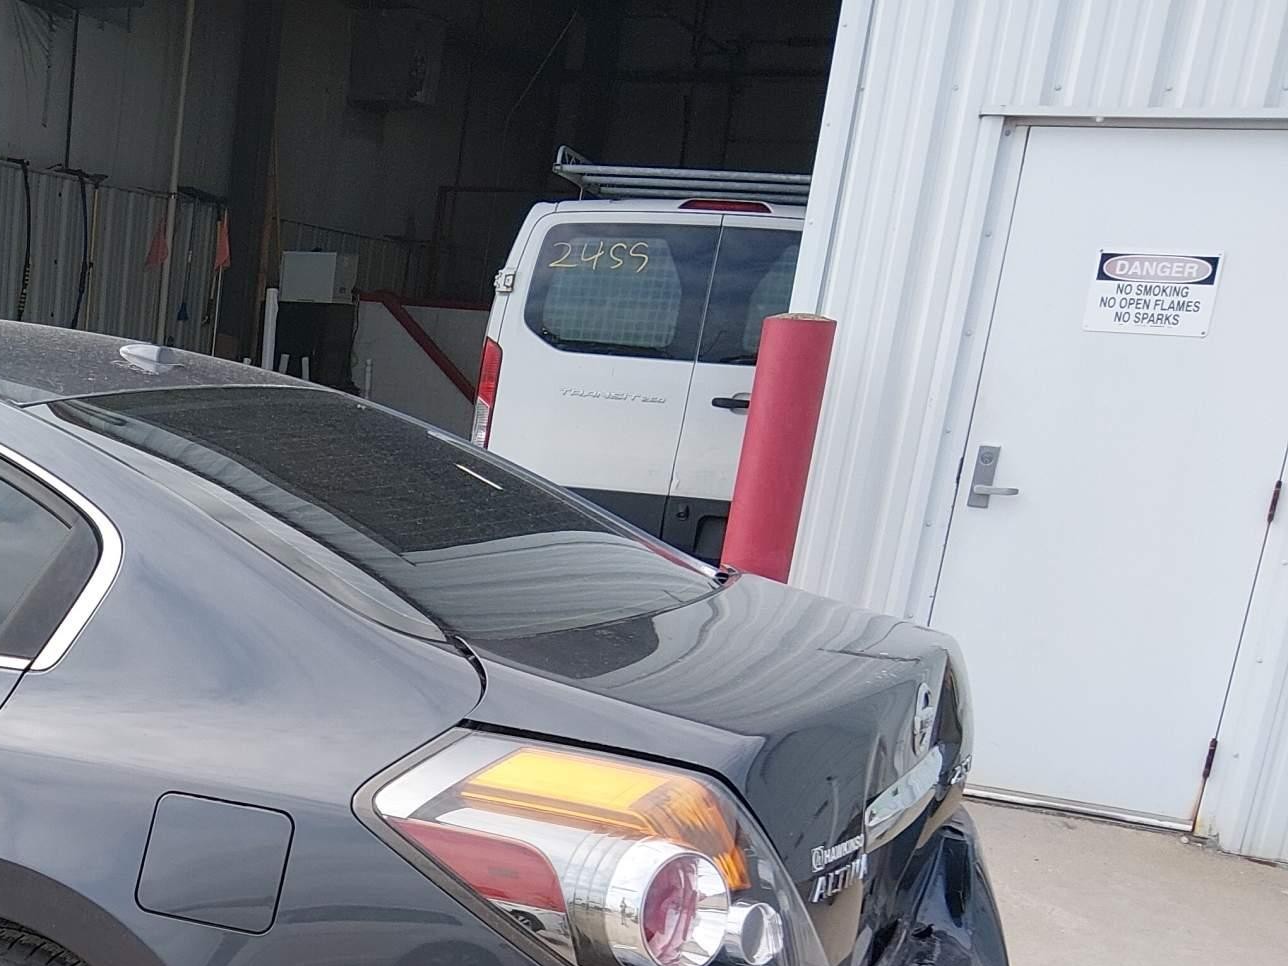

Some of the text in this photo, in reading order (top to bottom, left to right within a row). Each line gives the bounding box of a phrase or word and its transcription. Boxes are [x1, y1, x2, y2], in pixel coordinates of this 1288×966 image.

[1115, 260, 1198, 278] DANGER
[1115, 283, 1190, 298] NO SMOKING
[1099, 296, 1201, 313] NO OPEN FLAMES
[1113, 311, 1180, 326] NO SPARKS
